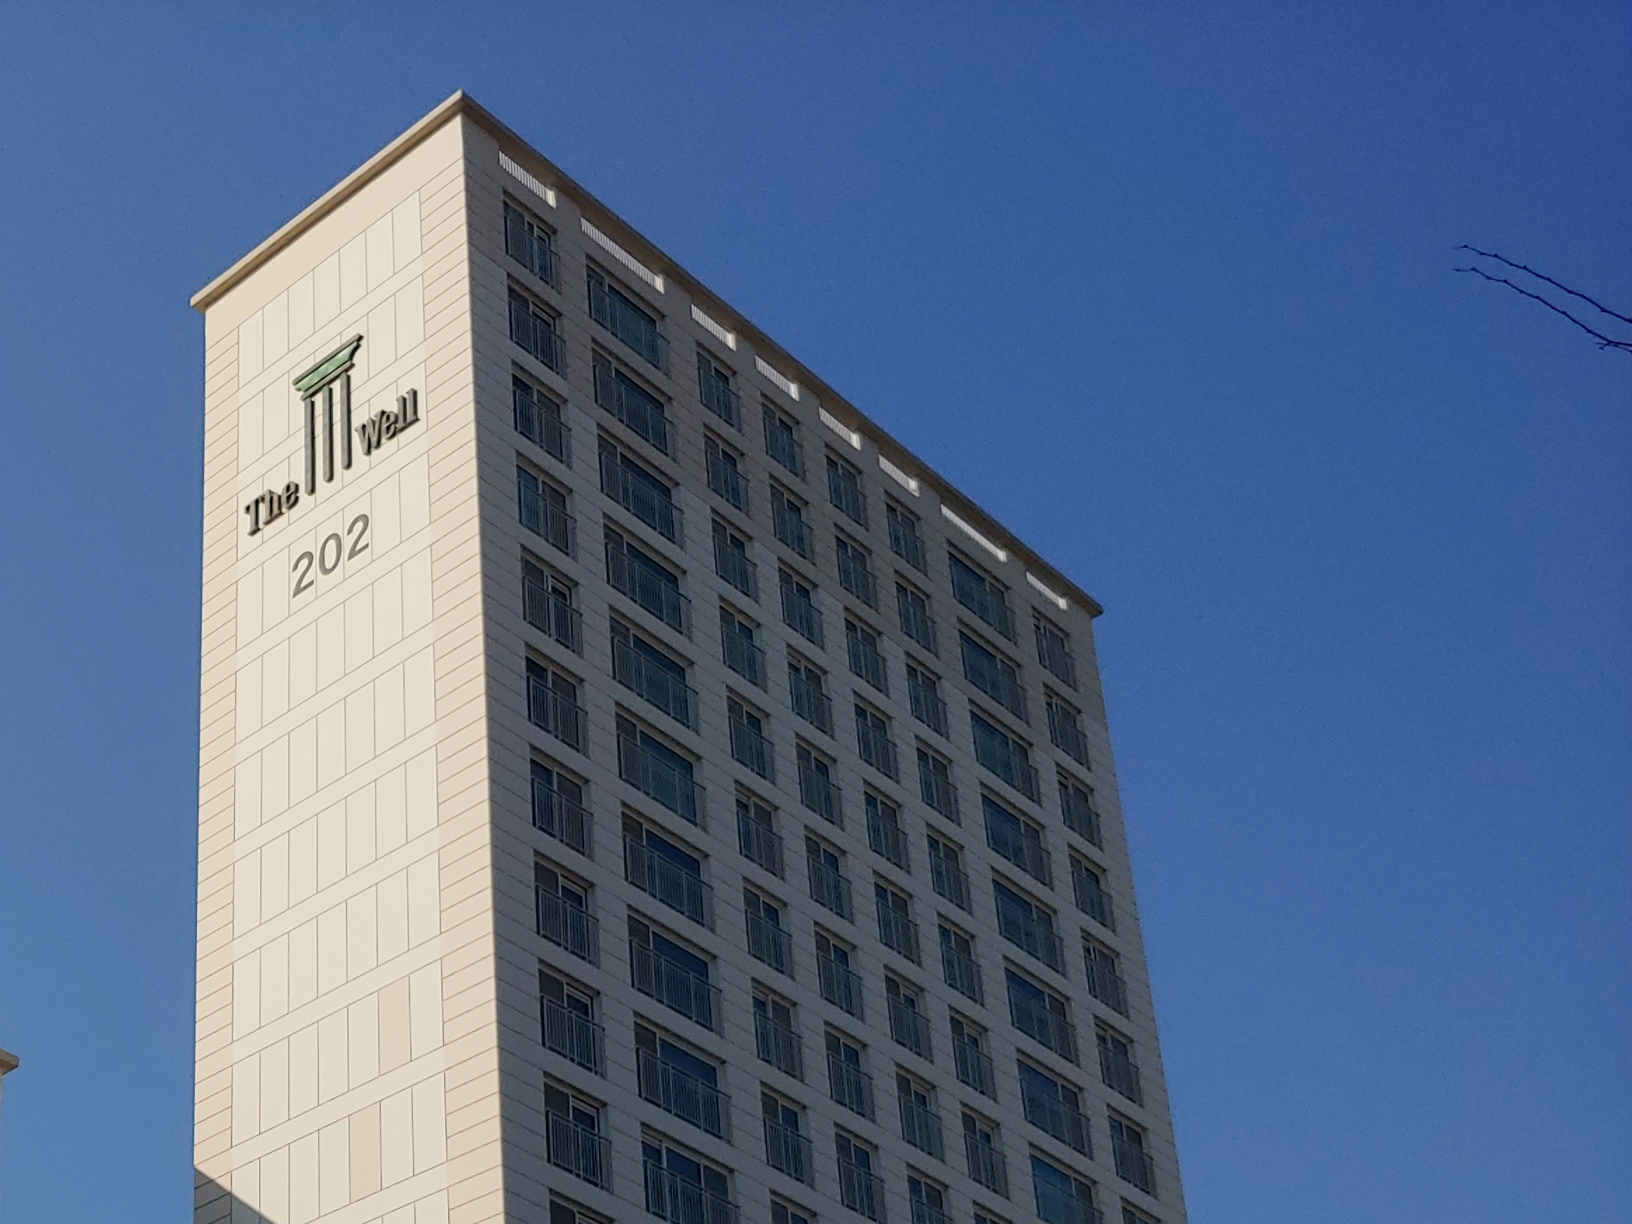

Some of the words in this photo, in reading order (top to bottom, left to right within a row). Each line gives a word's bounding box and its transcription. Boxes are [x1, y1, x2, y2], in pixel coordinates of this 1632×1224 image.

[243, 480, 300, 537] The
[354, 387, 420, 456] Well
[291, 513, 370, 599] 202
